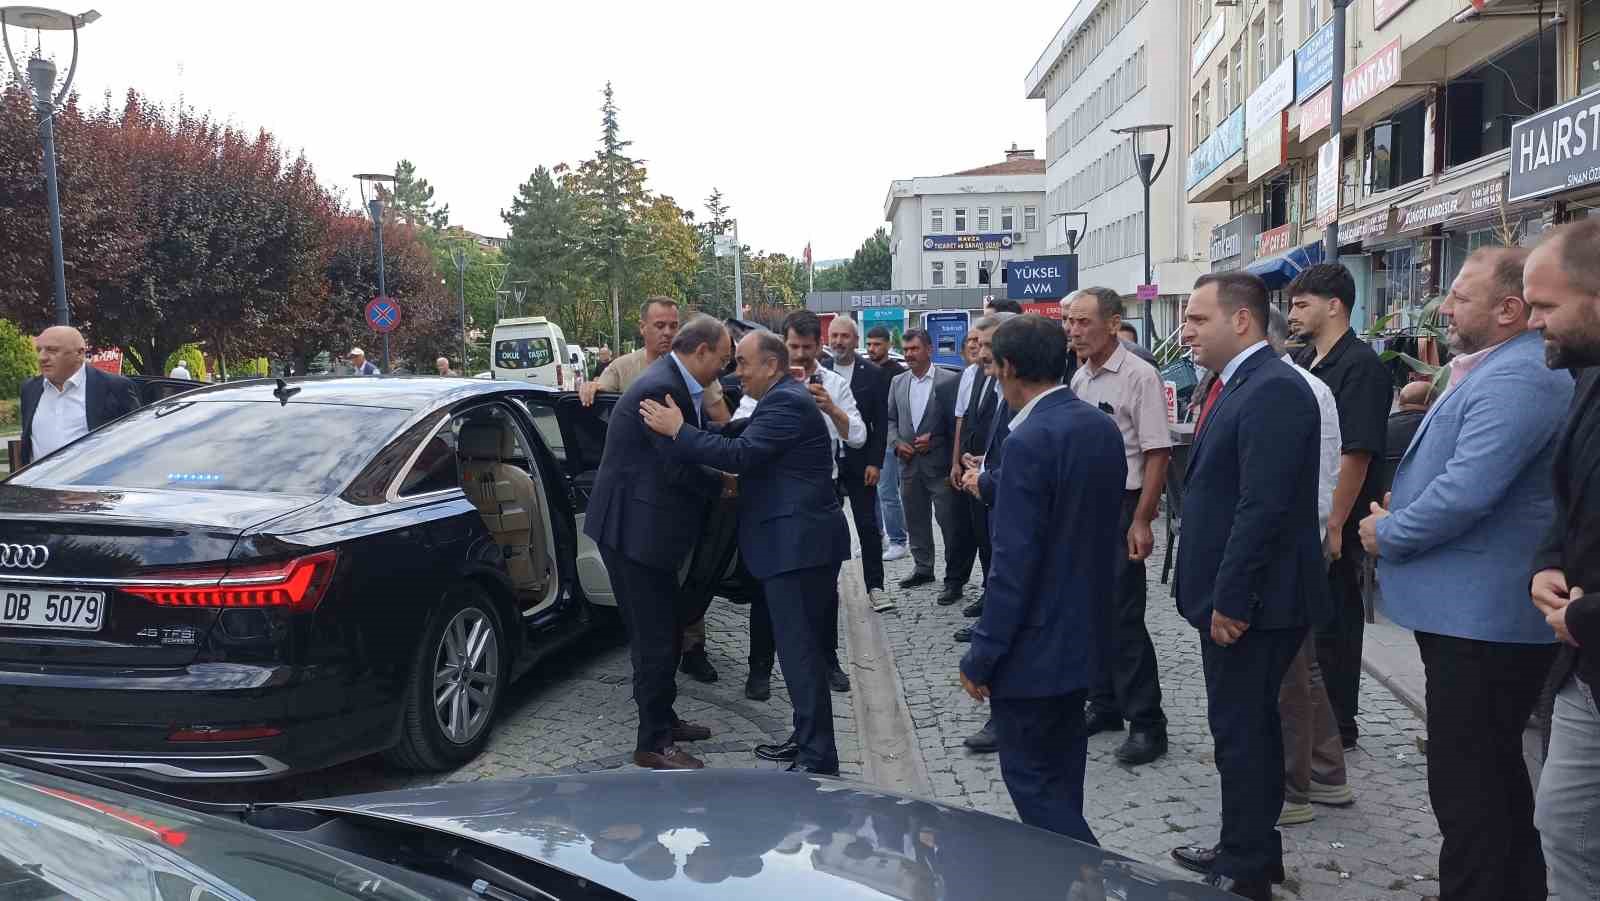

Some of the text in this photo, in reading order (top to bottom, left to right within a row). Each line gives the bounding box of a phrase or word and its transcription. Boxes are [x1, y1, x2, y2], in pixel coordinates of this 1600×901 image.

[1520, 104, 1600, 174] HAIRST
[1014, 265, 1061, 279] YÜKSEL
[1023, 283, 1052, 294] AVM
[851, 291, 928, 306] BELEDİYE
[4, 592, 99, 624] DB 5079
